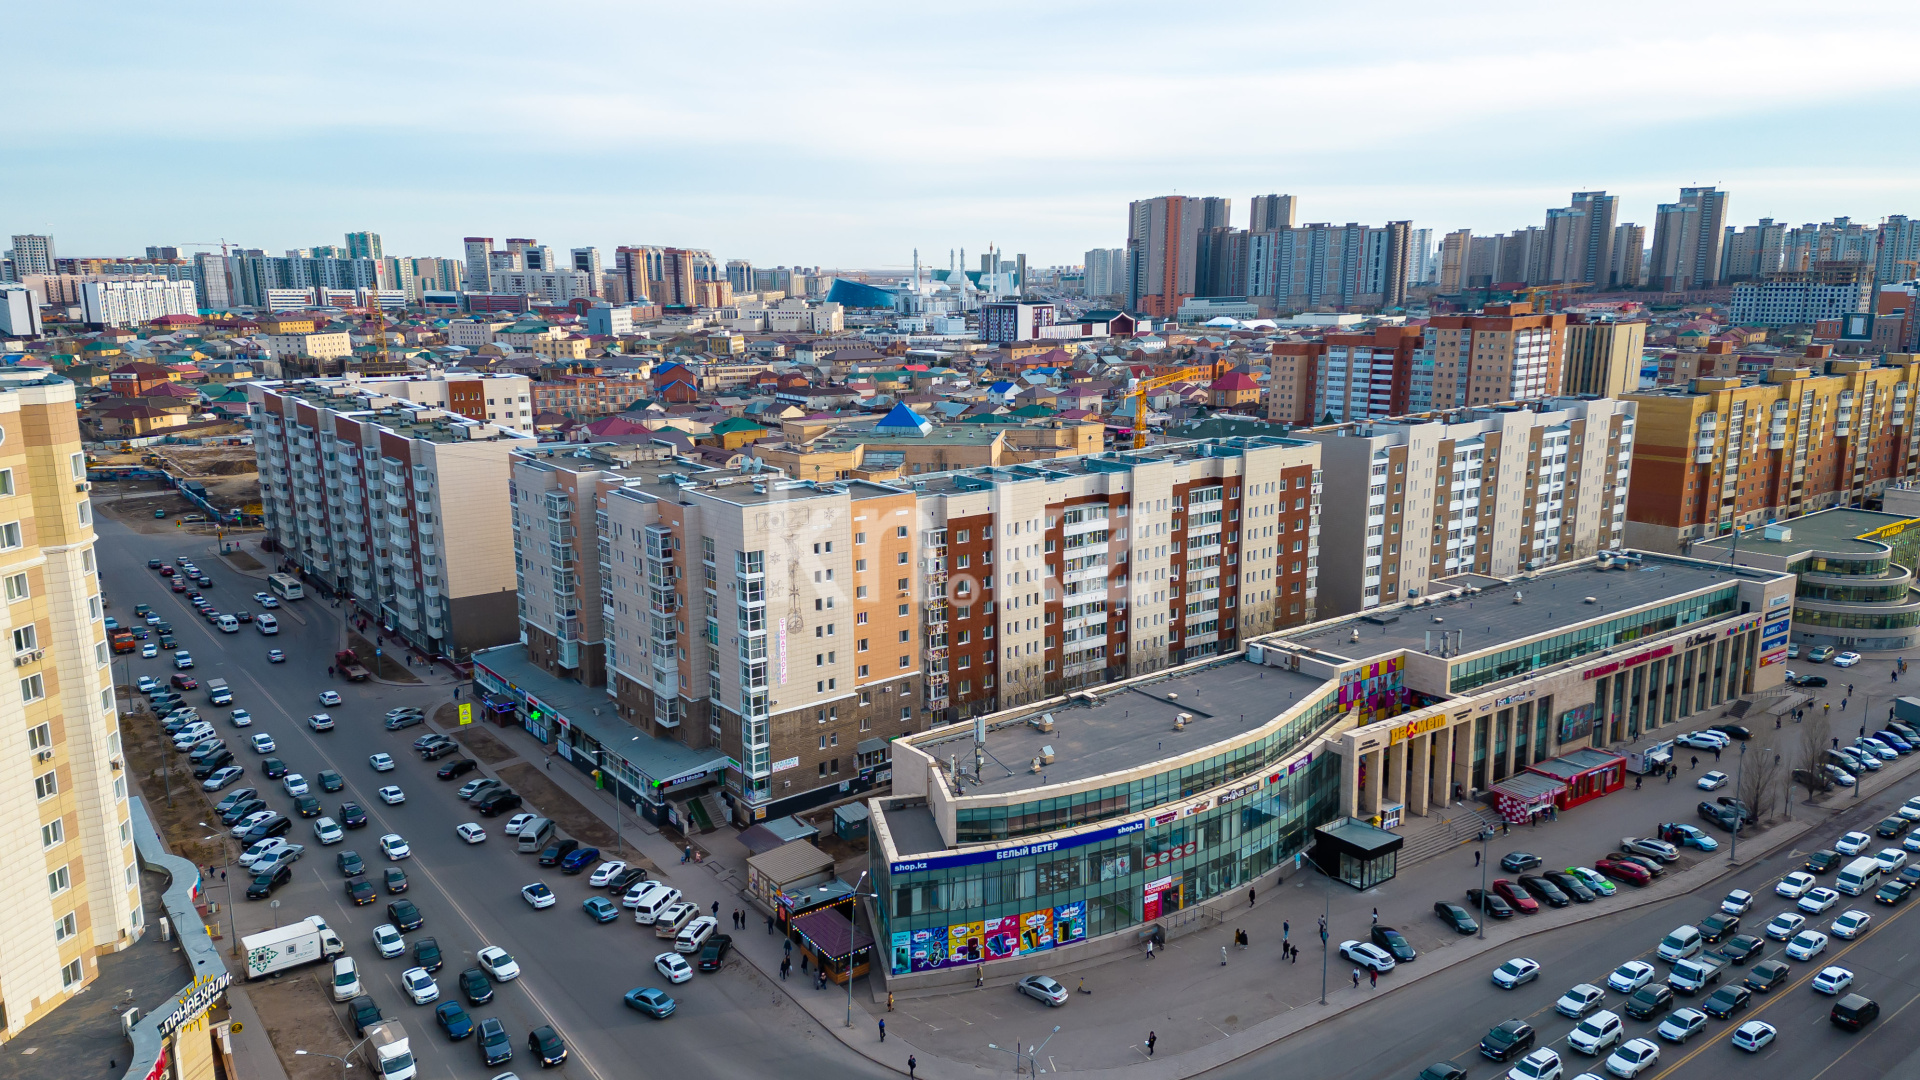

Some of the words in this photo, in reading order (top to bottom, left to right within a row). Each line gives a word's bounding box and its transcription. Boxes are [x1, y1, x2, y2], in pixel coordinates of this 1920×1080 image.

[779, 618, 787, 684] СТОМАТОЛОГИЯ
[672, 776, 686, 785] RAM
[686, 772, 705, 783] Mobile
[1117, 822, 1144, 835] shop.kz
[996, 846, 1029, 860] БЕЛЫЙ
[1031, 842, 1059, 854] ВЕТЕР
[894, 860, 928, 872] shop.kz
[164, 972, 230, 1033] ПАНАЕХАЛИ
